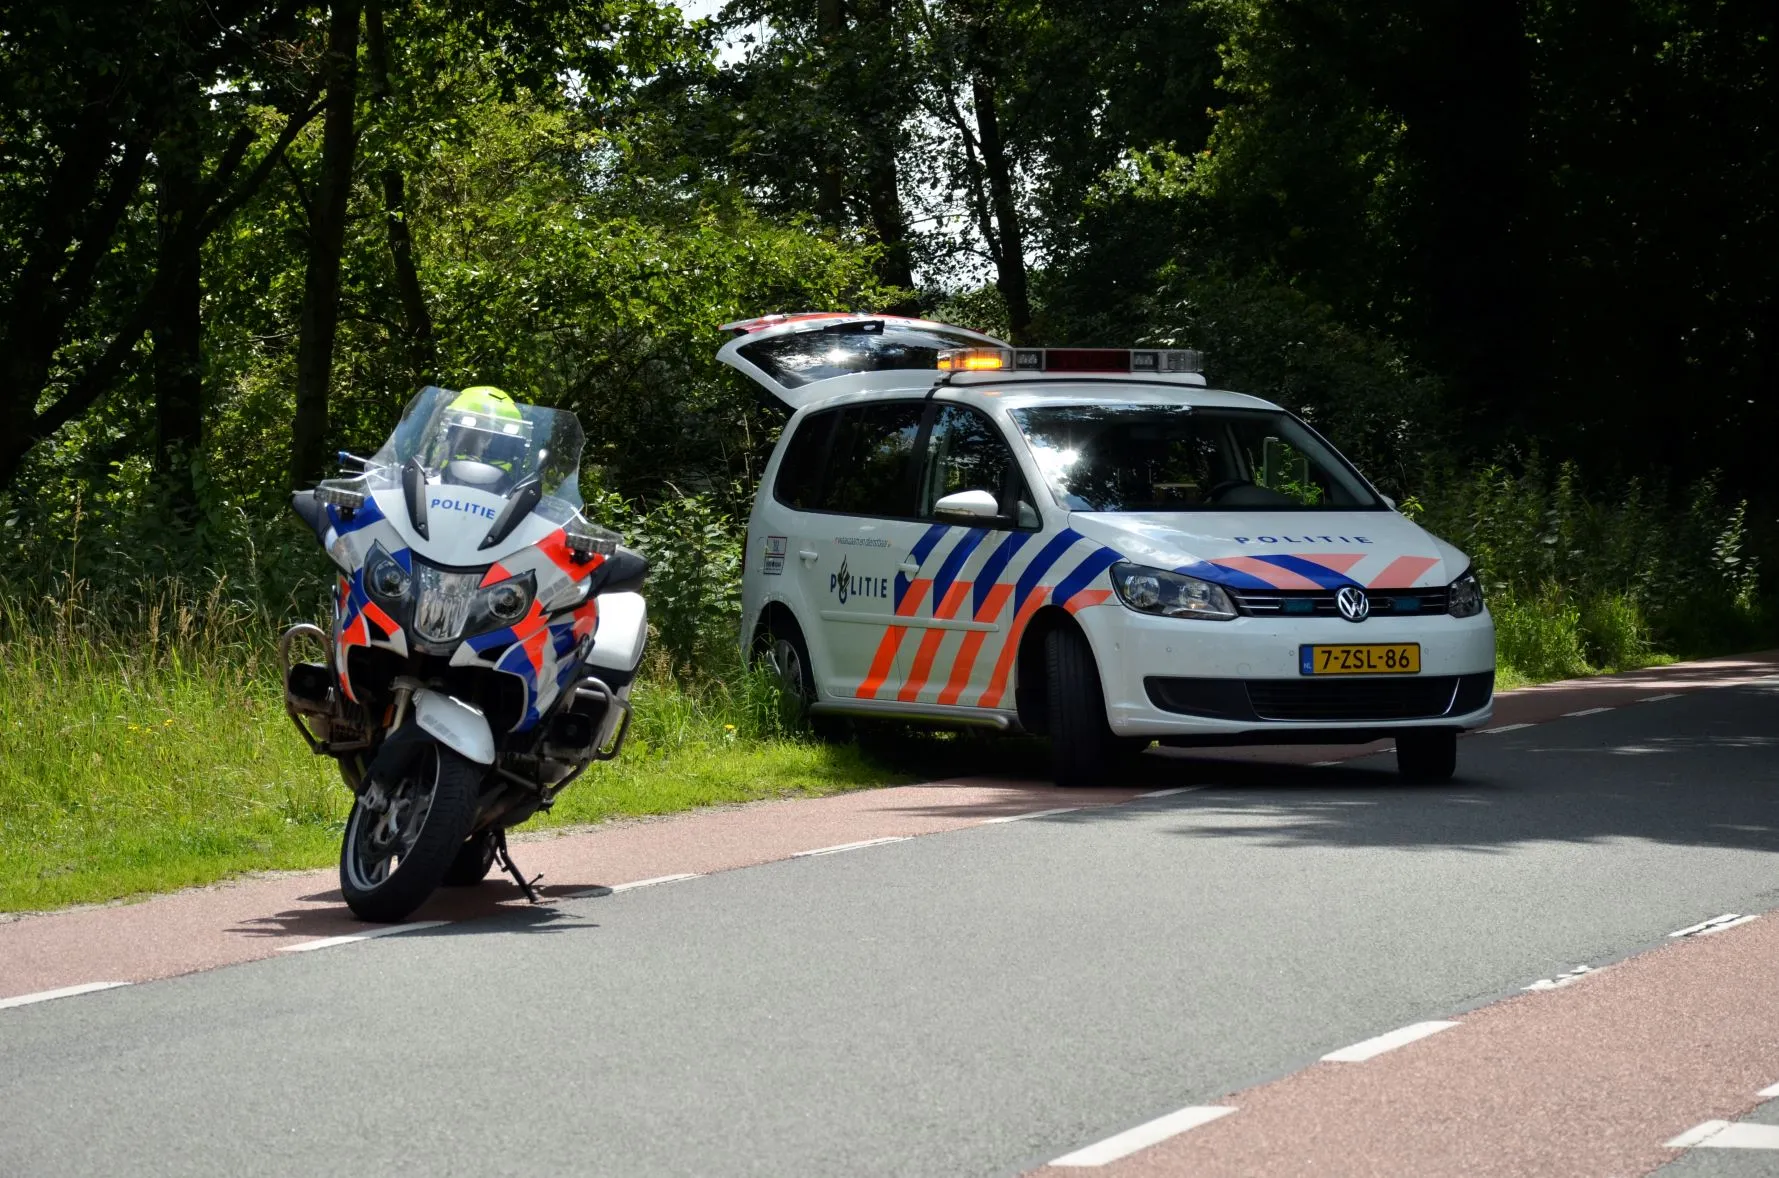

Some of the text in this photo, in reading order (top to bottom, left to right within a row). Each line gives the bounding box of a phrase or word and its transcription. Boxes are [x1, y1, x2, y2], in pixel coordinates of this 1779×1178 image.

[431, 498, 496, 520] POLITIE
[1234, 535, 1374, 545] POLITIE
[830, 573, 888, 604] POLITIE
[1321, 648, 1410, 670] 7-ZSL-86
